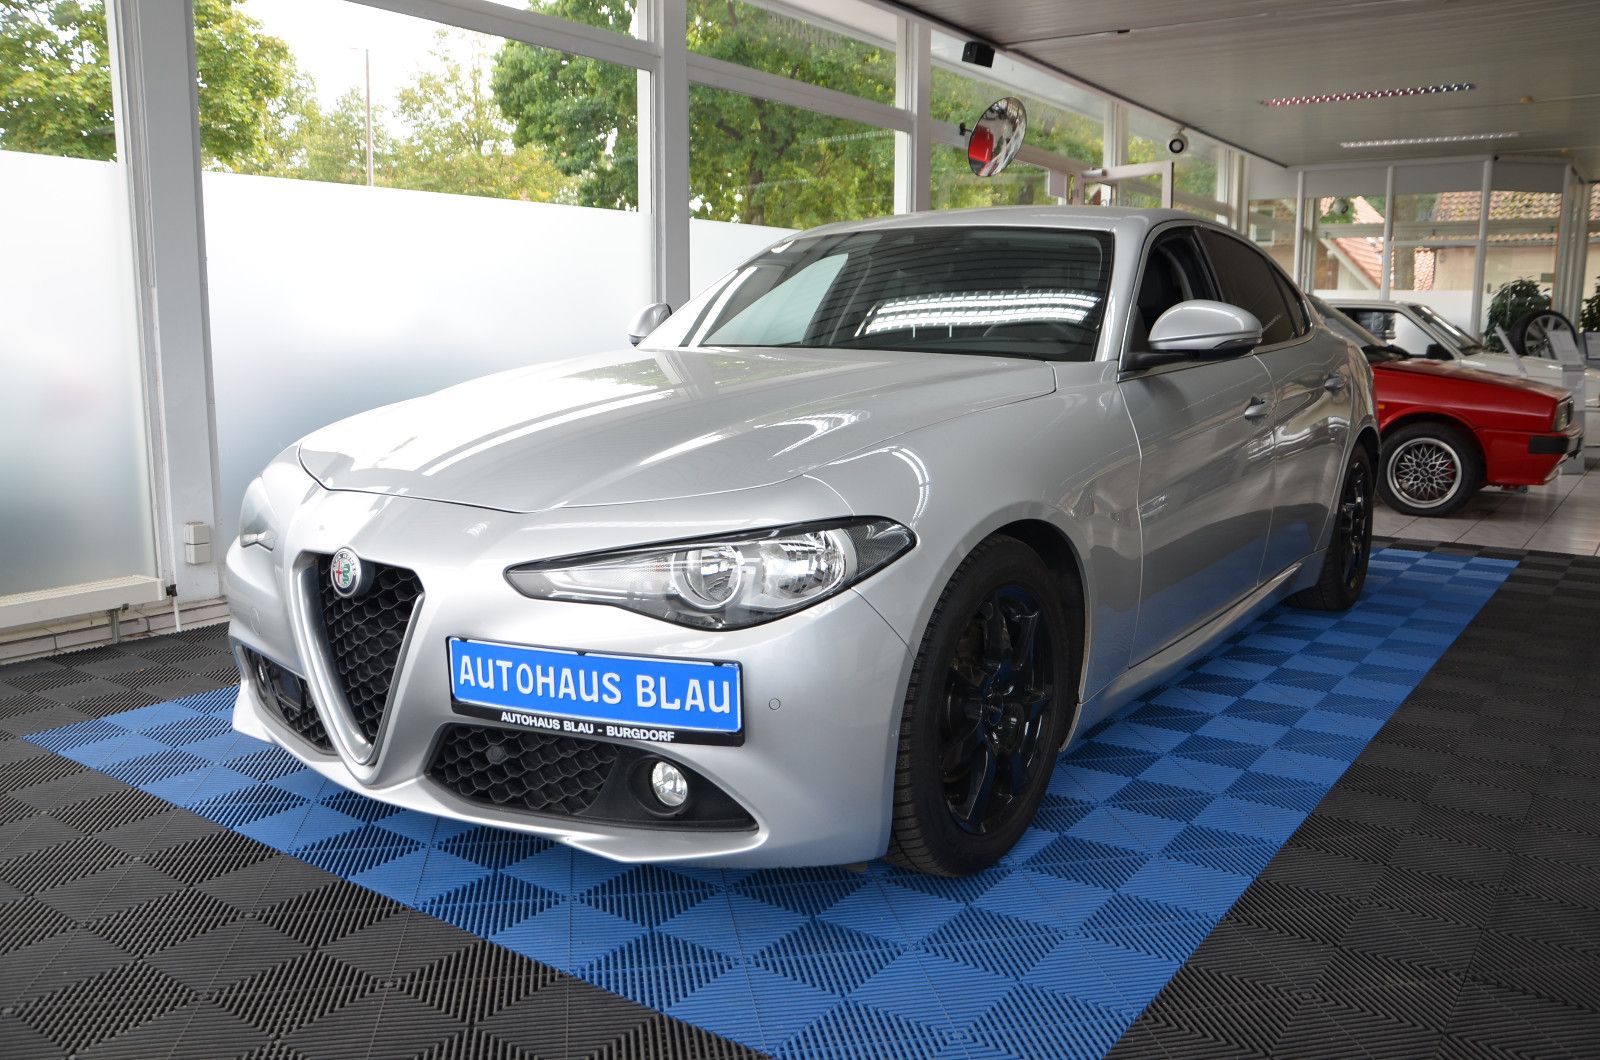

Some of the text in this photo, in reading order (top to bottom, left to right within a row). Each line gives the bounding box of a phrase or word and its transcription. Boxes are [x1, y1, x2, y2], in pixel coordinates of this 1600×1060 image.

[459, 655, 731, 714] AUTOHAUS BLAU
[501, 711, 561, 730] AUTOHAUS
[563, 720, 594, 734] BLAU
[606, 725, 675, 742] BURGDORF
